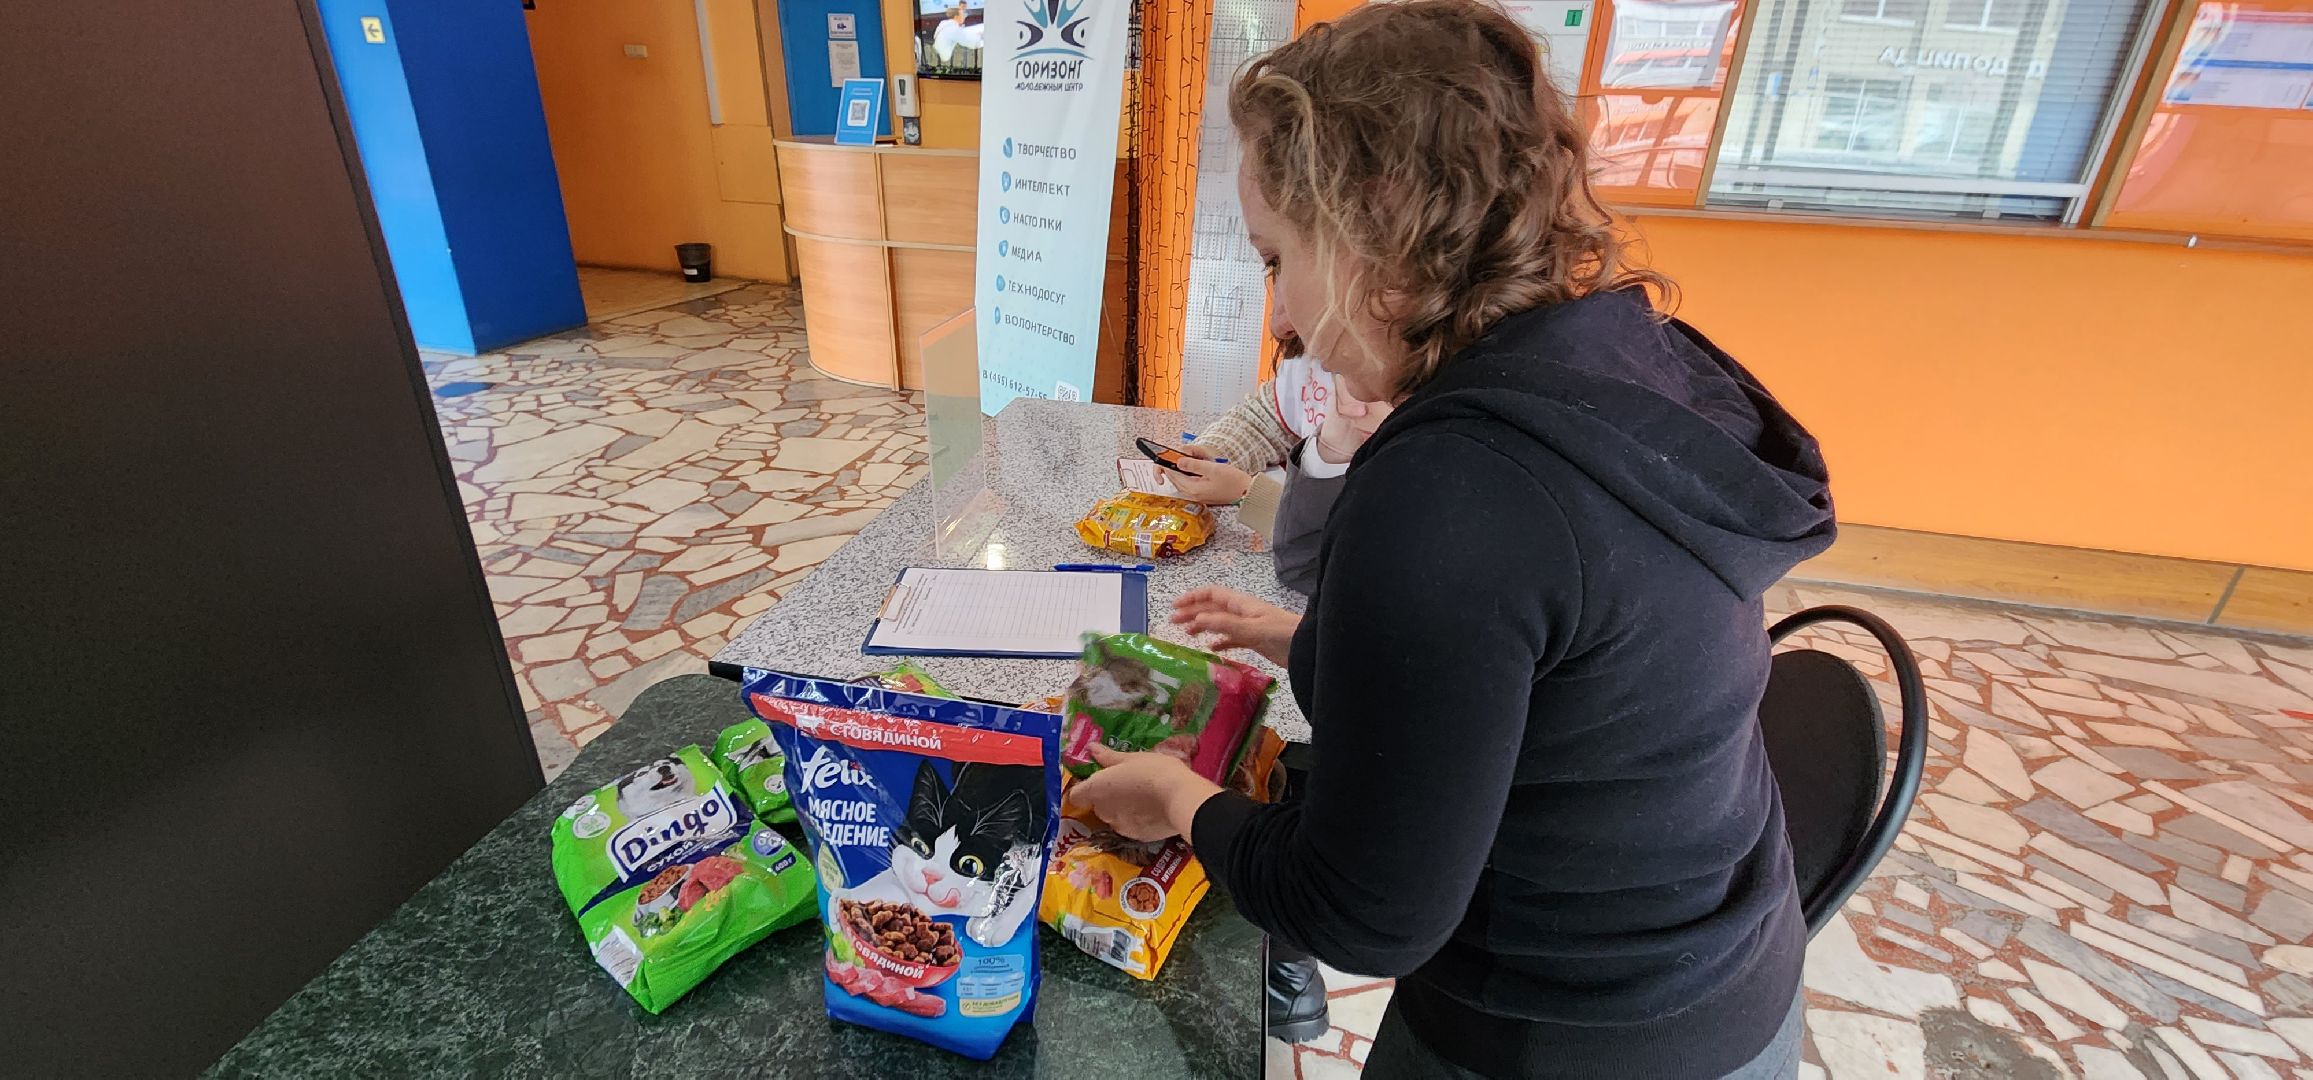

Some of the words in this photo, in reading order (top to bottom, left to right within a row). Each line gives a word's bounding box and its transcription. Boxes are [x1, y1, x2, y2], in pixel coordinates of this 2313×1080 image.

[1015, 60, 1084, 80] ГОРИЗОНТ
[1064, 82, 1084, 92] ЦЕНТР
[1017, 142, 1077, 161] ТВОРЧЕСТВО
[1014, 178, 1071, 197] ИНТЕЛЛЕКТ
[1013, 212, 1063, 231] НАСТОЛКИ
[1011, 245, 1042, 263] МЕДИА
[1008, 279, 1067, 305] ТЕХНОДОСУГ
[1004, 314, 1075, 346] ВОЛОНТЕРСТВО
[842, 722, 942, 750] ГОВЯДИНОЙ
[808, 796, 877, 823] МЯСНОЕ
[621, 799, 720, 865] Dingo
[646, 841, 693, 873] СУХОЙ
